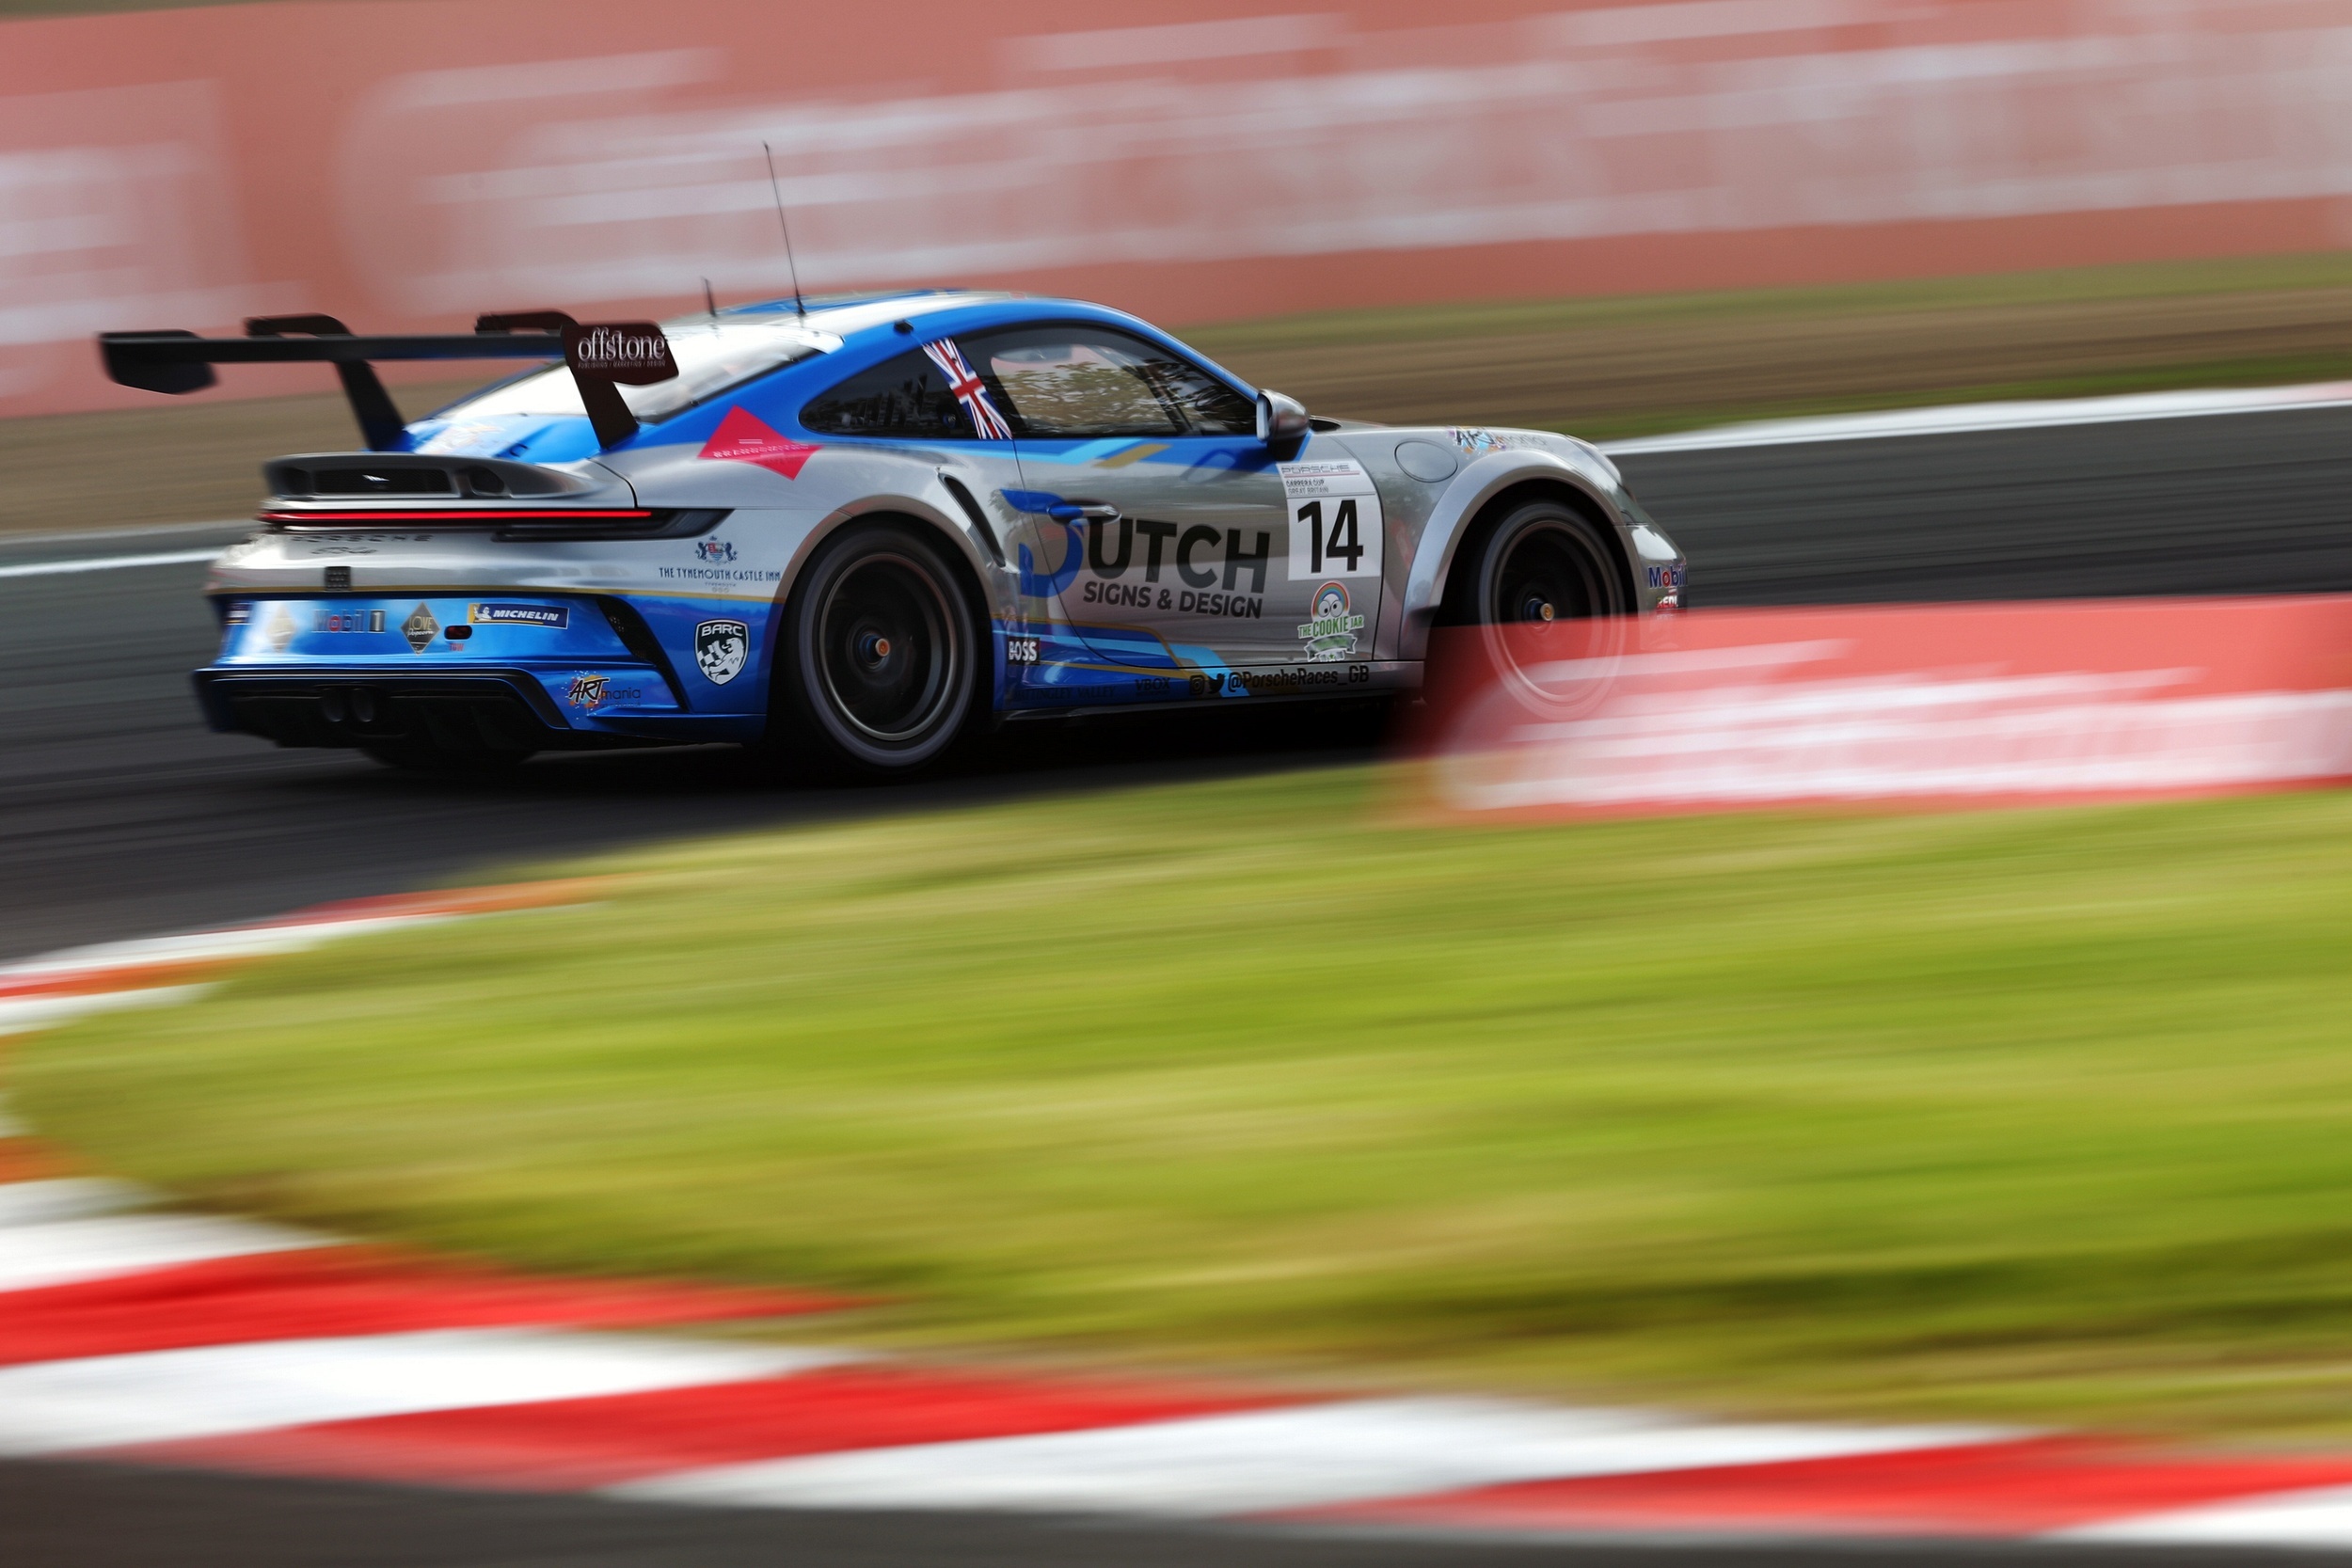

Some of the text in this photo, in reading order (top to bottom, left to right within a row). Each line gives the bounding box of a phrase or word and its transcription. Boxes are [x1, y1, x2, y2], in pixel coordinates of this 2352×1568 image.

[578, 326, 666, 361] offstone
[1281, 464, 1351, 474] PORSCHE
[1307, 486, 1329, 495] BRITAIN
[1297, 499, 1364, 574] 14
[659, 567, 781, 581] THE TYNEMOUTH CASTLE INN
[1083, 581, 1263, 619] SIGNS & DESIGN
[493, 610, 559, 621] MICHELIN
[409, 616, 434, 630] LOVE
[1298, 616, 1363, 637] THE COOKIE JAR
[701, 624, 743, 637] BARC
[449, 642, 465, 652] TOW
[1009, 641, 1038, 661] BOSS
[1135, 677, 1170, 690] VBOX
[1228, 665, 1369, 692] @PorscheRaces_GB
